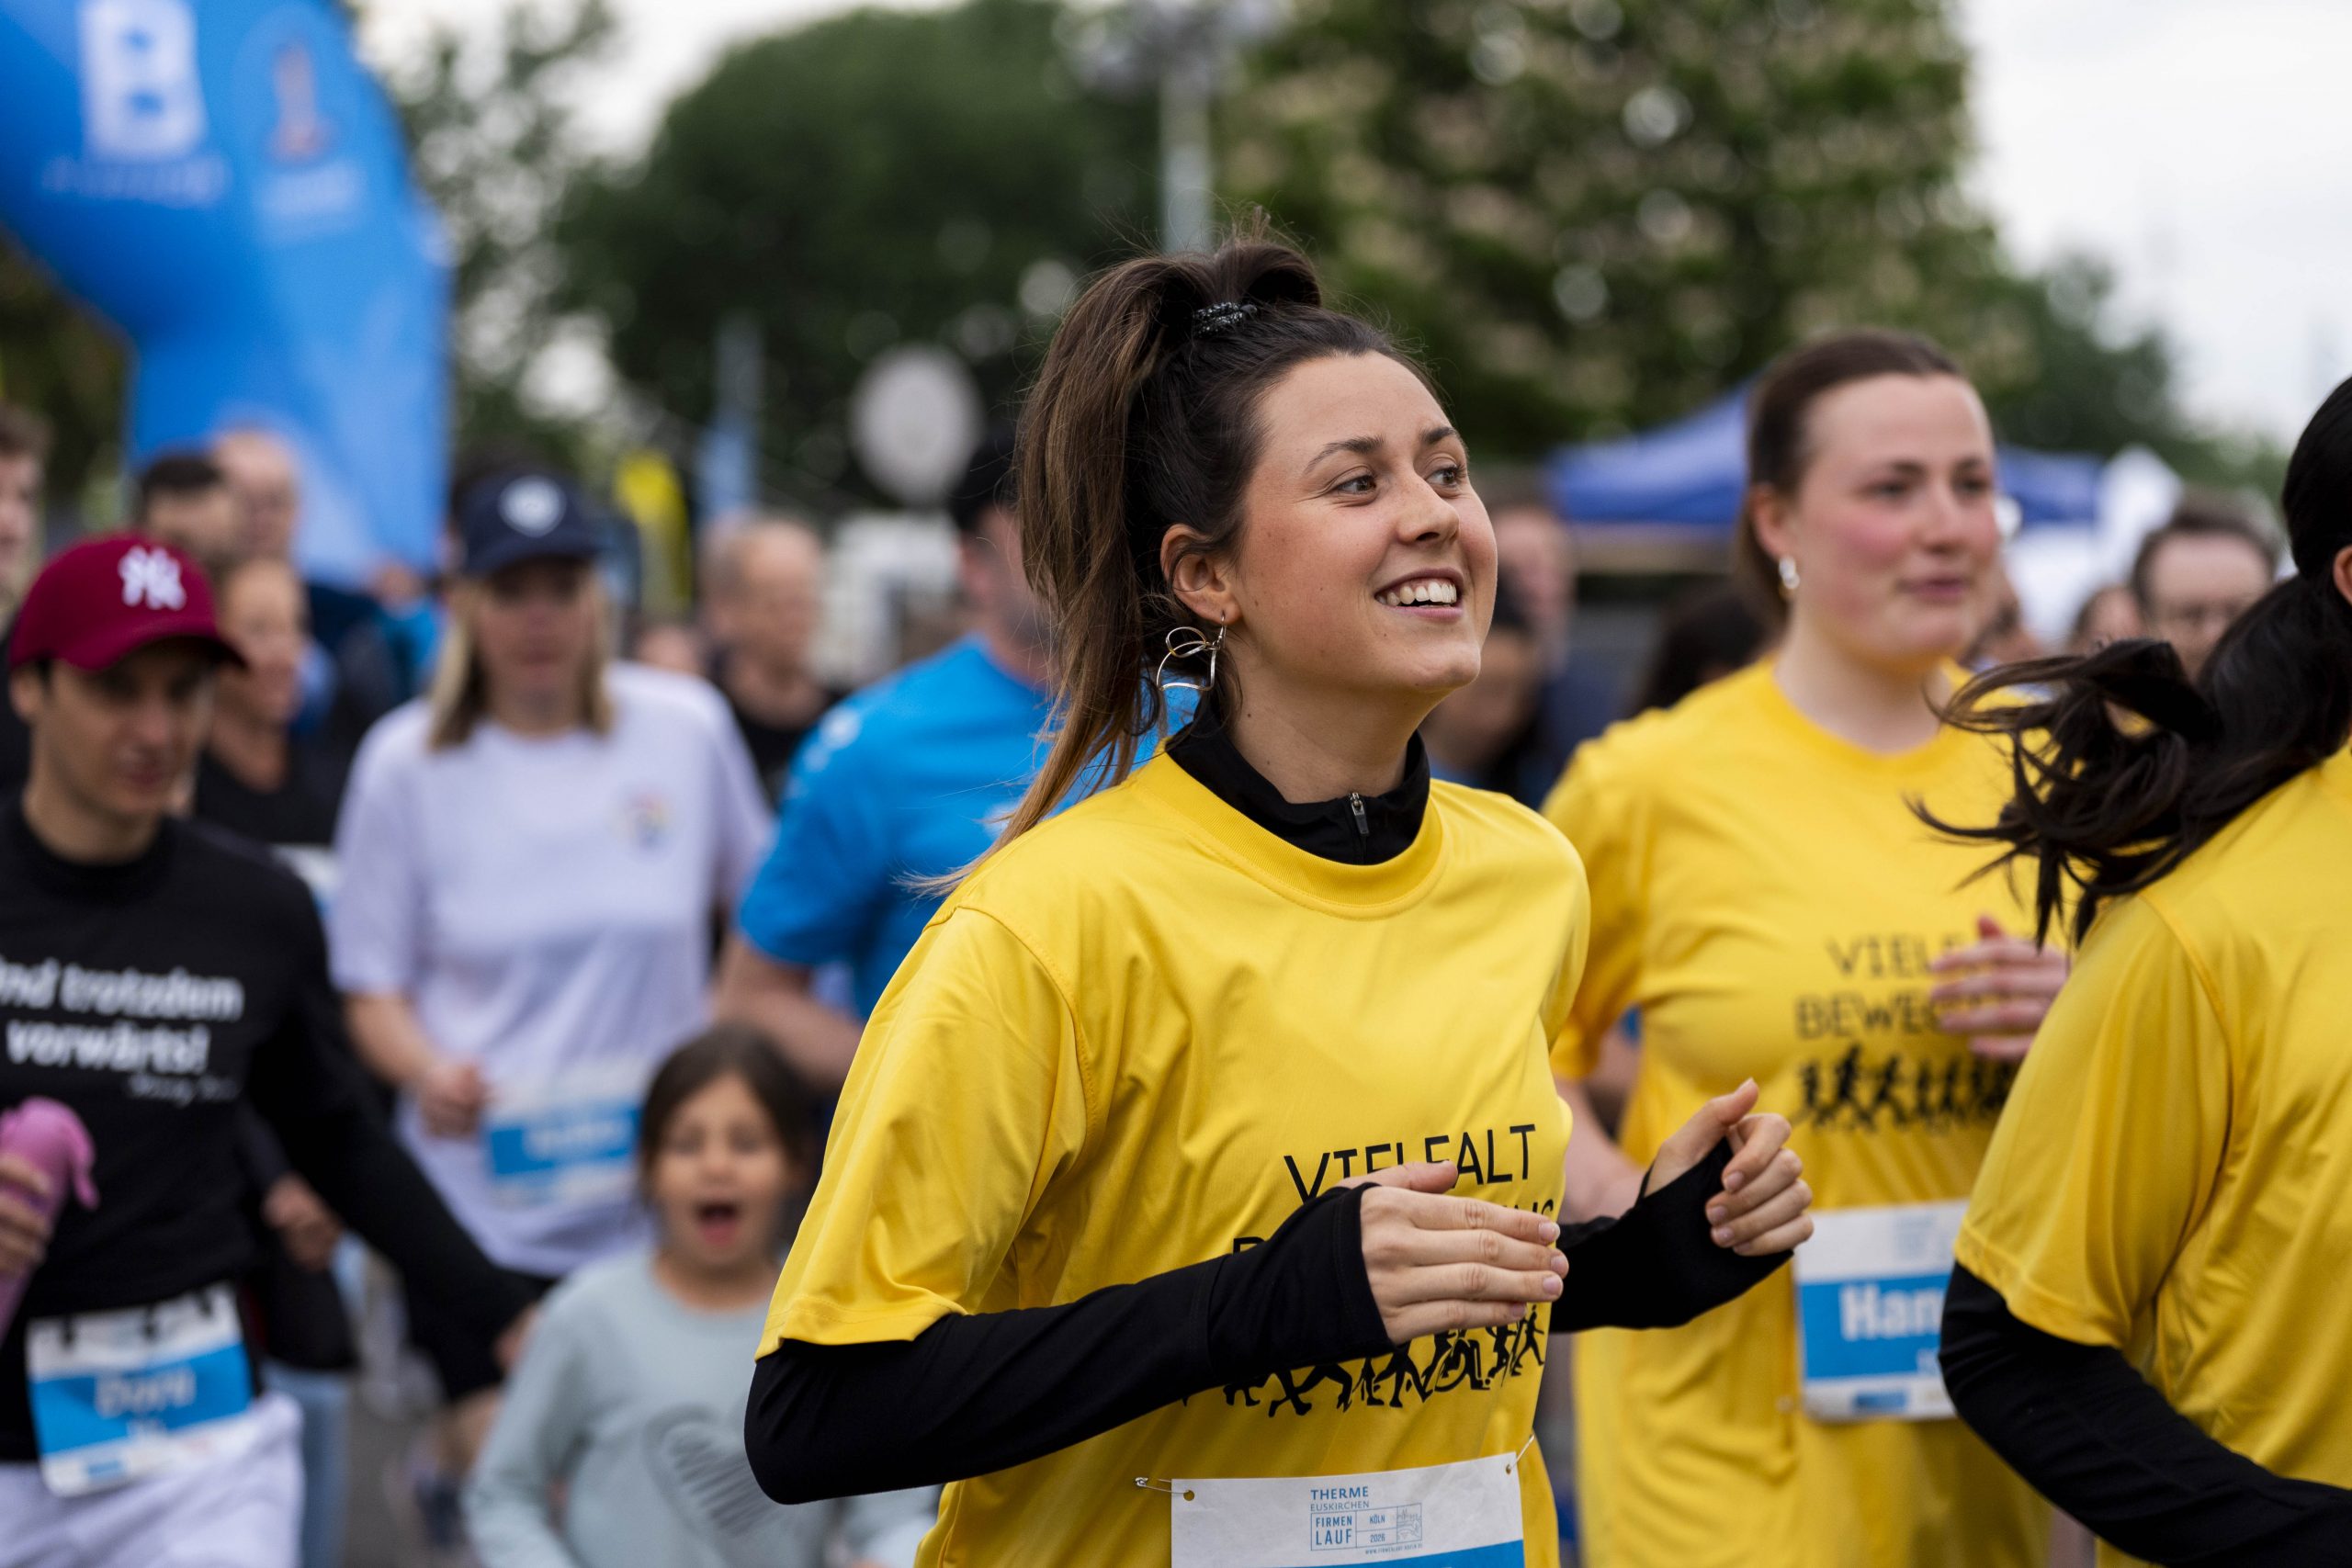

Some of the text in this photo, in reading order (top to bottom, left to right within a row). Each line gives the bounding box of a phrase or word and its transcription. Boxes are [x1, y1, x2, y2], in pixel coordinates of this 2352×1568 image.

[81, 0, 206, 160] B
[1310, 1485, 1369, 1500] THERME
[1310, 1500, 1370, 1512] EUSKIRCHEN
[1316, 1515, 1352, 1528] FIRMEN
[1369, 1514, 1385, 1525] KÖLN
[1316, 1528, 1352, 1546] LAUF
